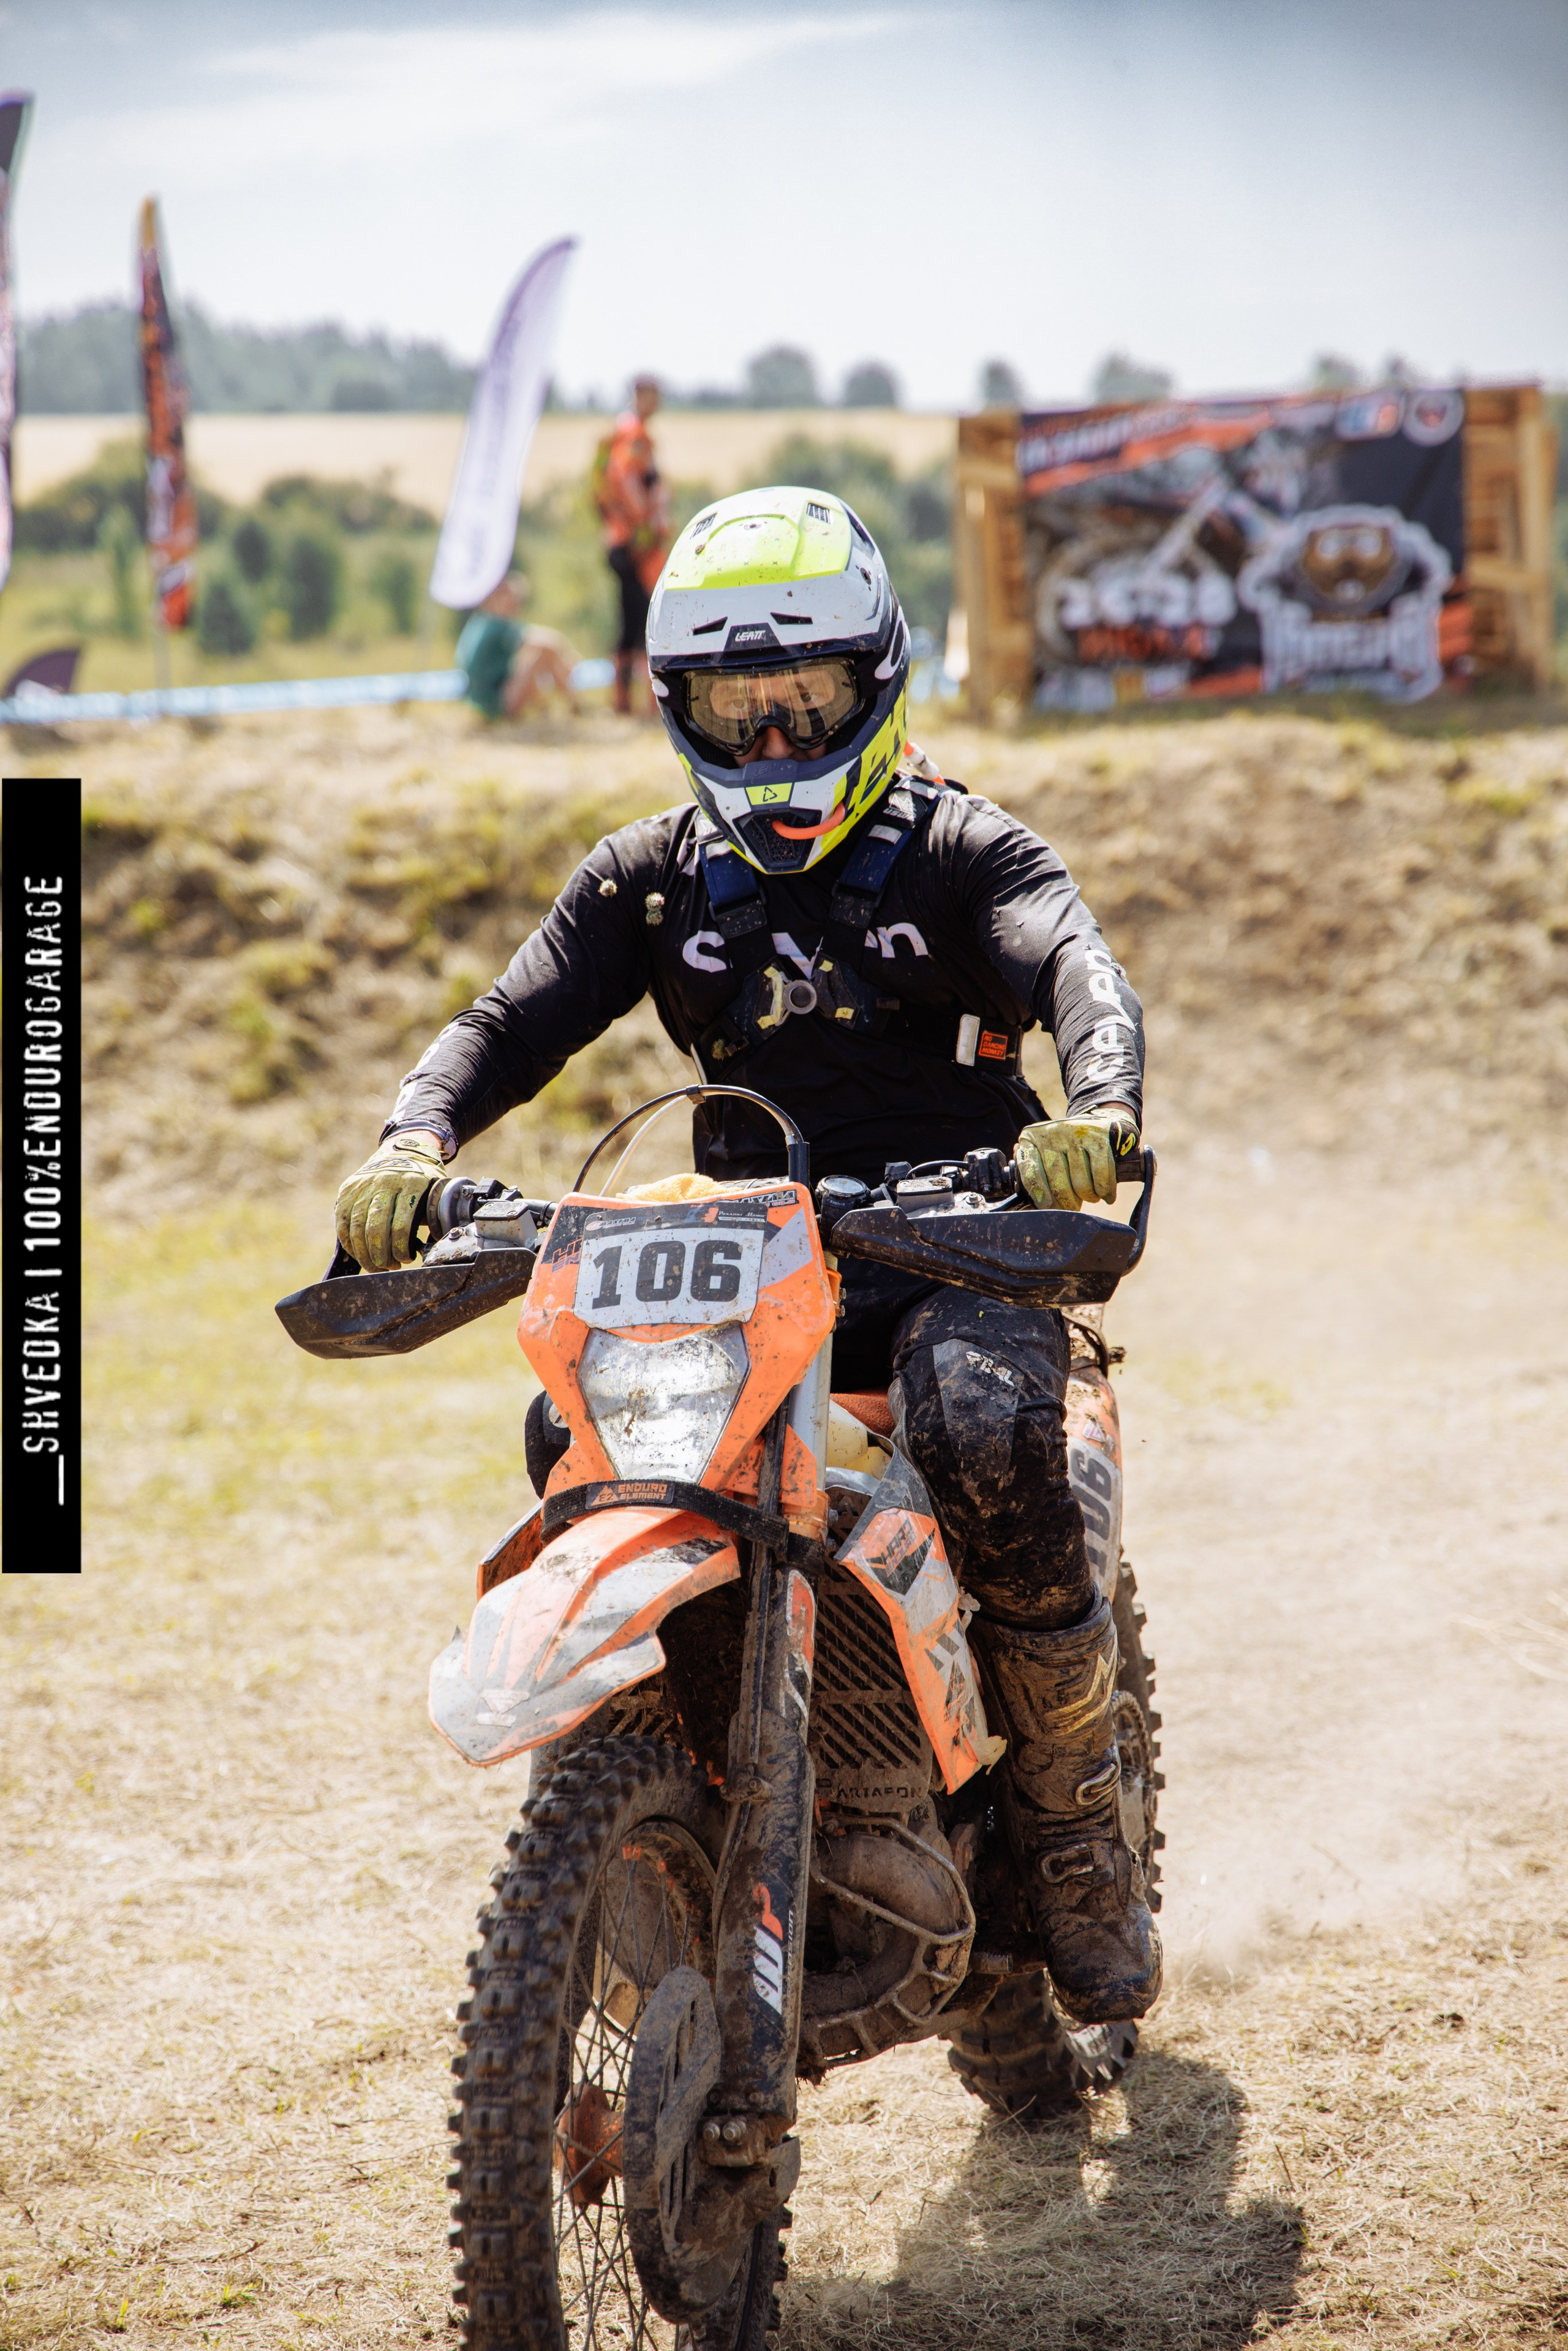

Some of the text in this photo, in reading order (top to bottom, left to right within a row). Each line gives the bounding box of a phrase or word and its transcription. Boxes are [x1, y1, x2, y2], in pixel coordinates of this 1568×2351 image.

[734, 630, 766, 642] LEATT
[592, 1240, 742, 1310] 106
[618, 1482, 668, 1493] ENDURO
